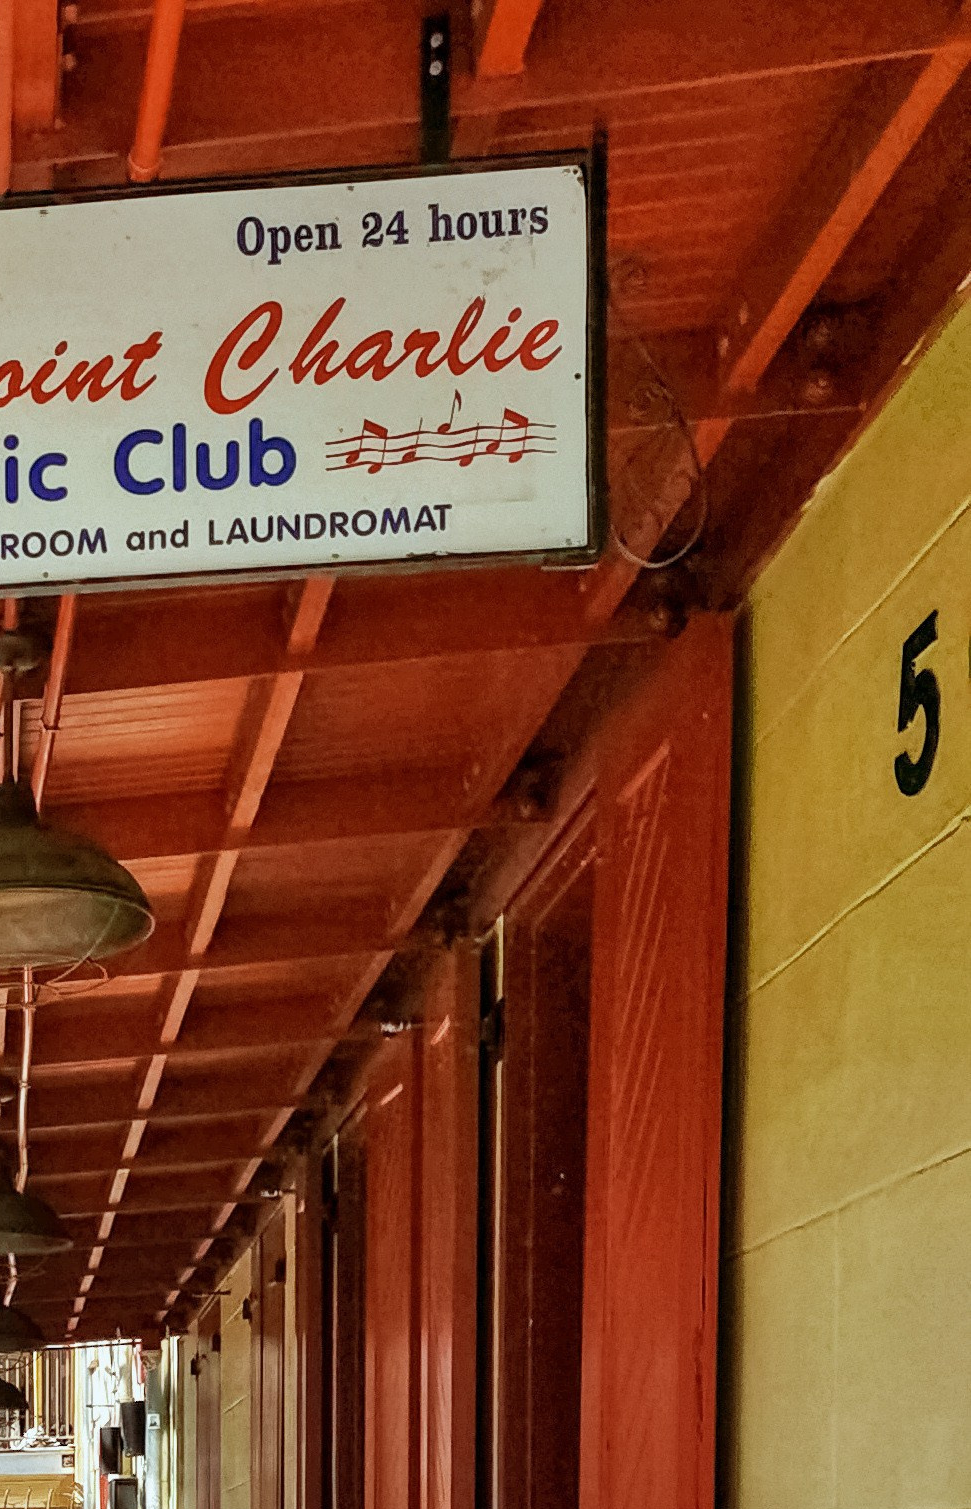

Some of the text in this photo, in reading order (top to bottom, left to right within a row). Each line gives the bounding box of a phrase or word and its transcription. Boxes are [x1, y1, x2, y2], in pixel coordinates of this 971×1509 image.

[236, 203, 549, 265] Open 24 hours
[203, 296, 563, 415] Charlie
[113, 417, 297, 496] Club
[125, 520, 191, 553] and
[208, 504, 453, 546] LAUNDROMAT
[894, 608, 971, 797] 5
